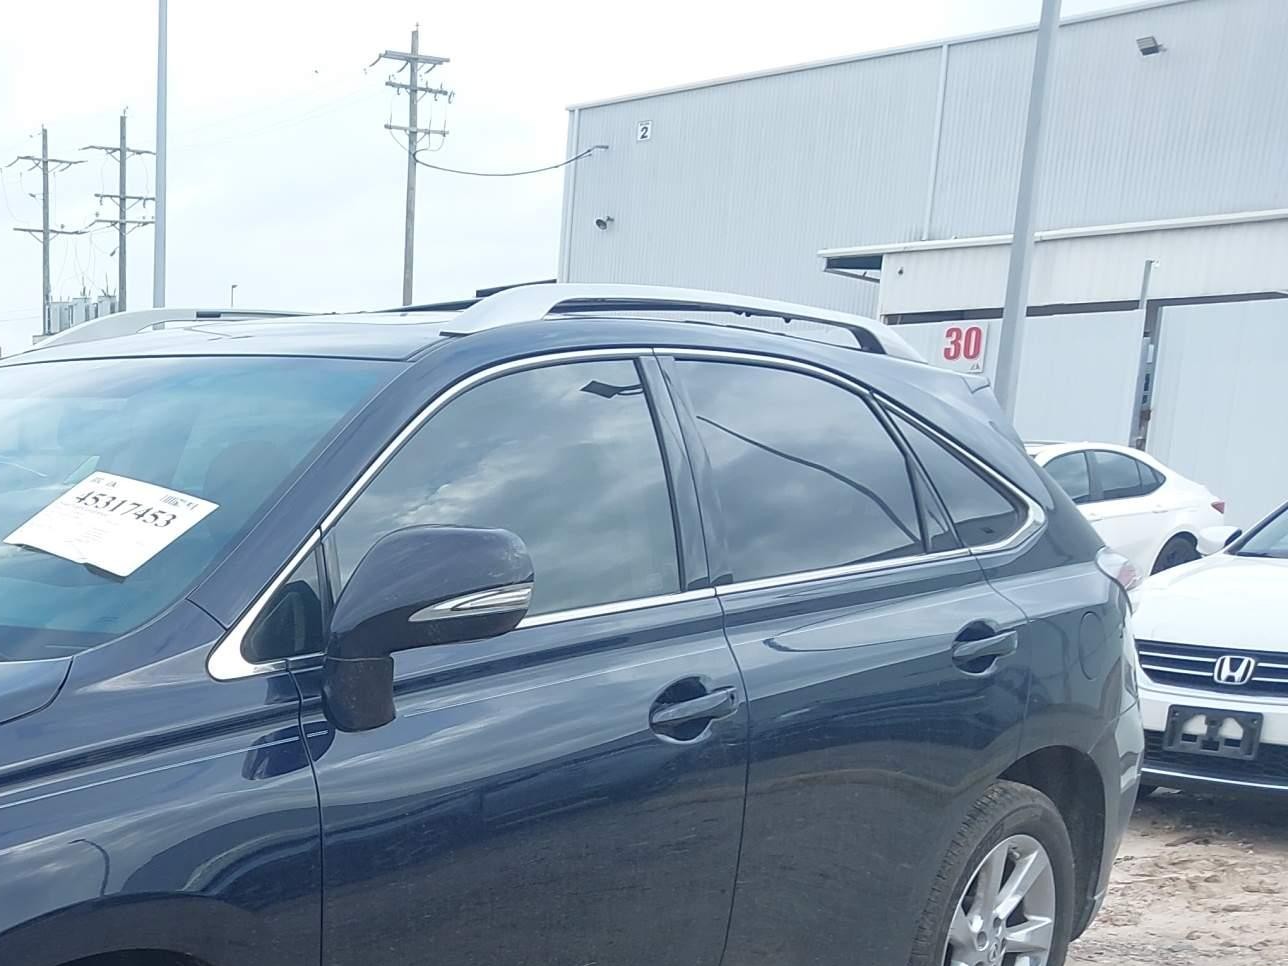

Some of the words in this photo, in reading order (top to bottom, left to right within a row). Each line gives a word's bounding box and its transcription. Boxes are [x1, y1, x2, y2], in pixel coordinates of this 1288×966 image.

[639, 126, 649, 140] 2
[943, 326, 982, 361] 30
[74, 490, 178, 528] 45317453
